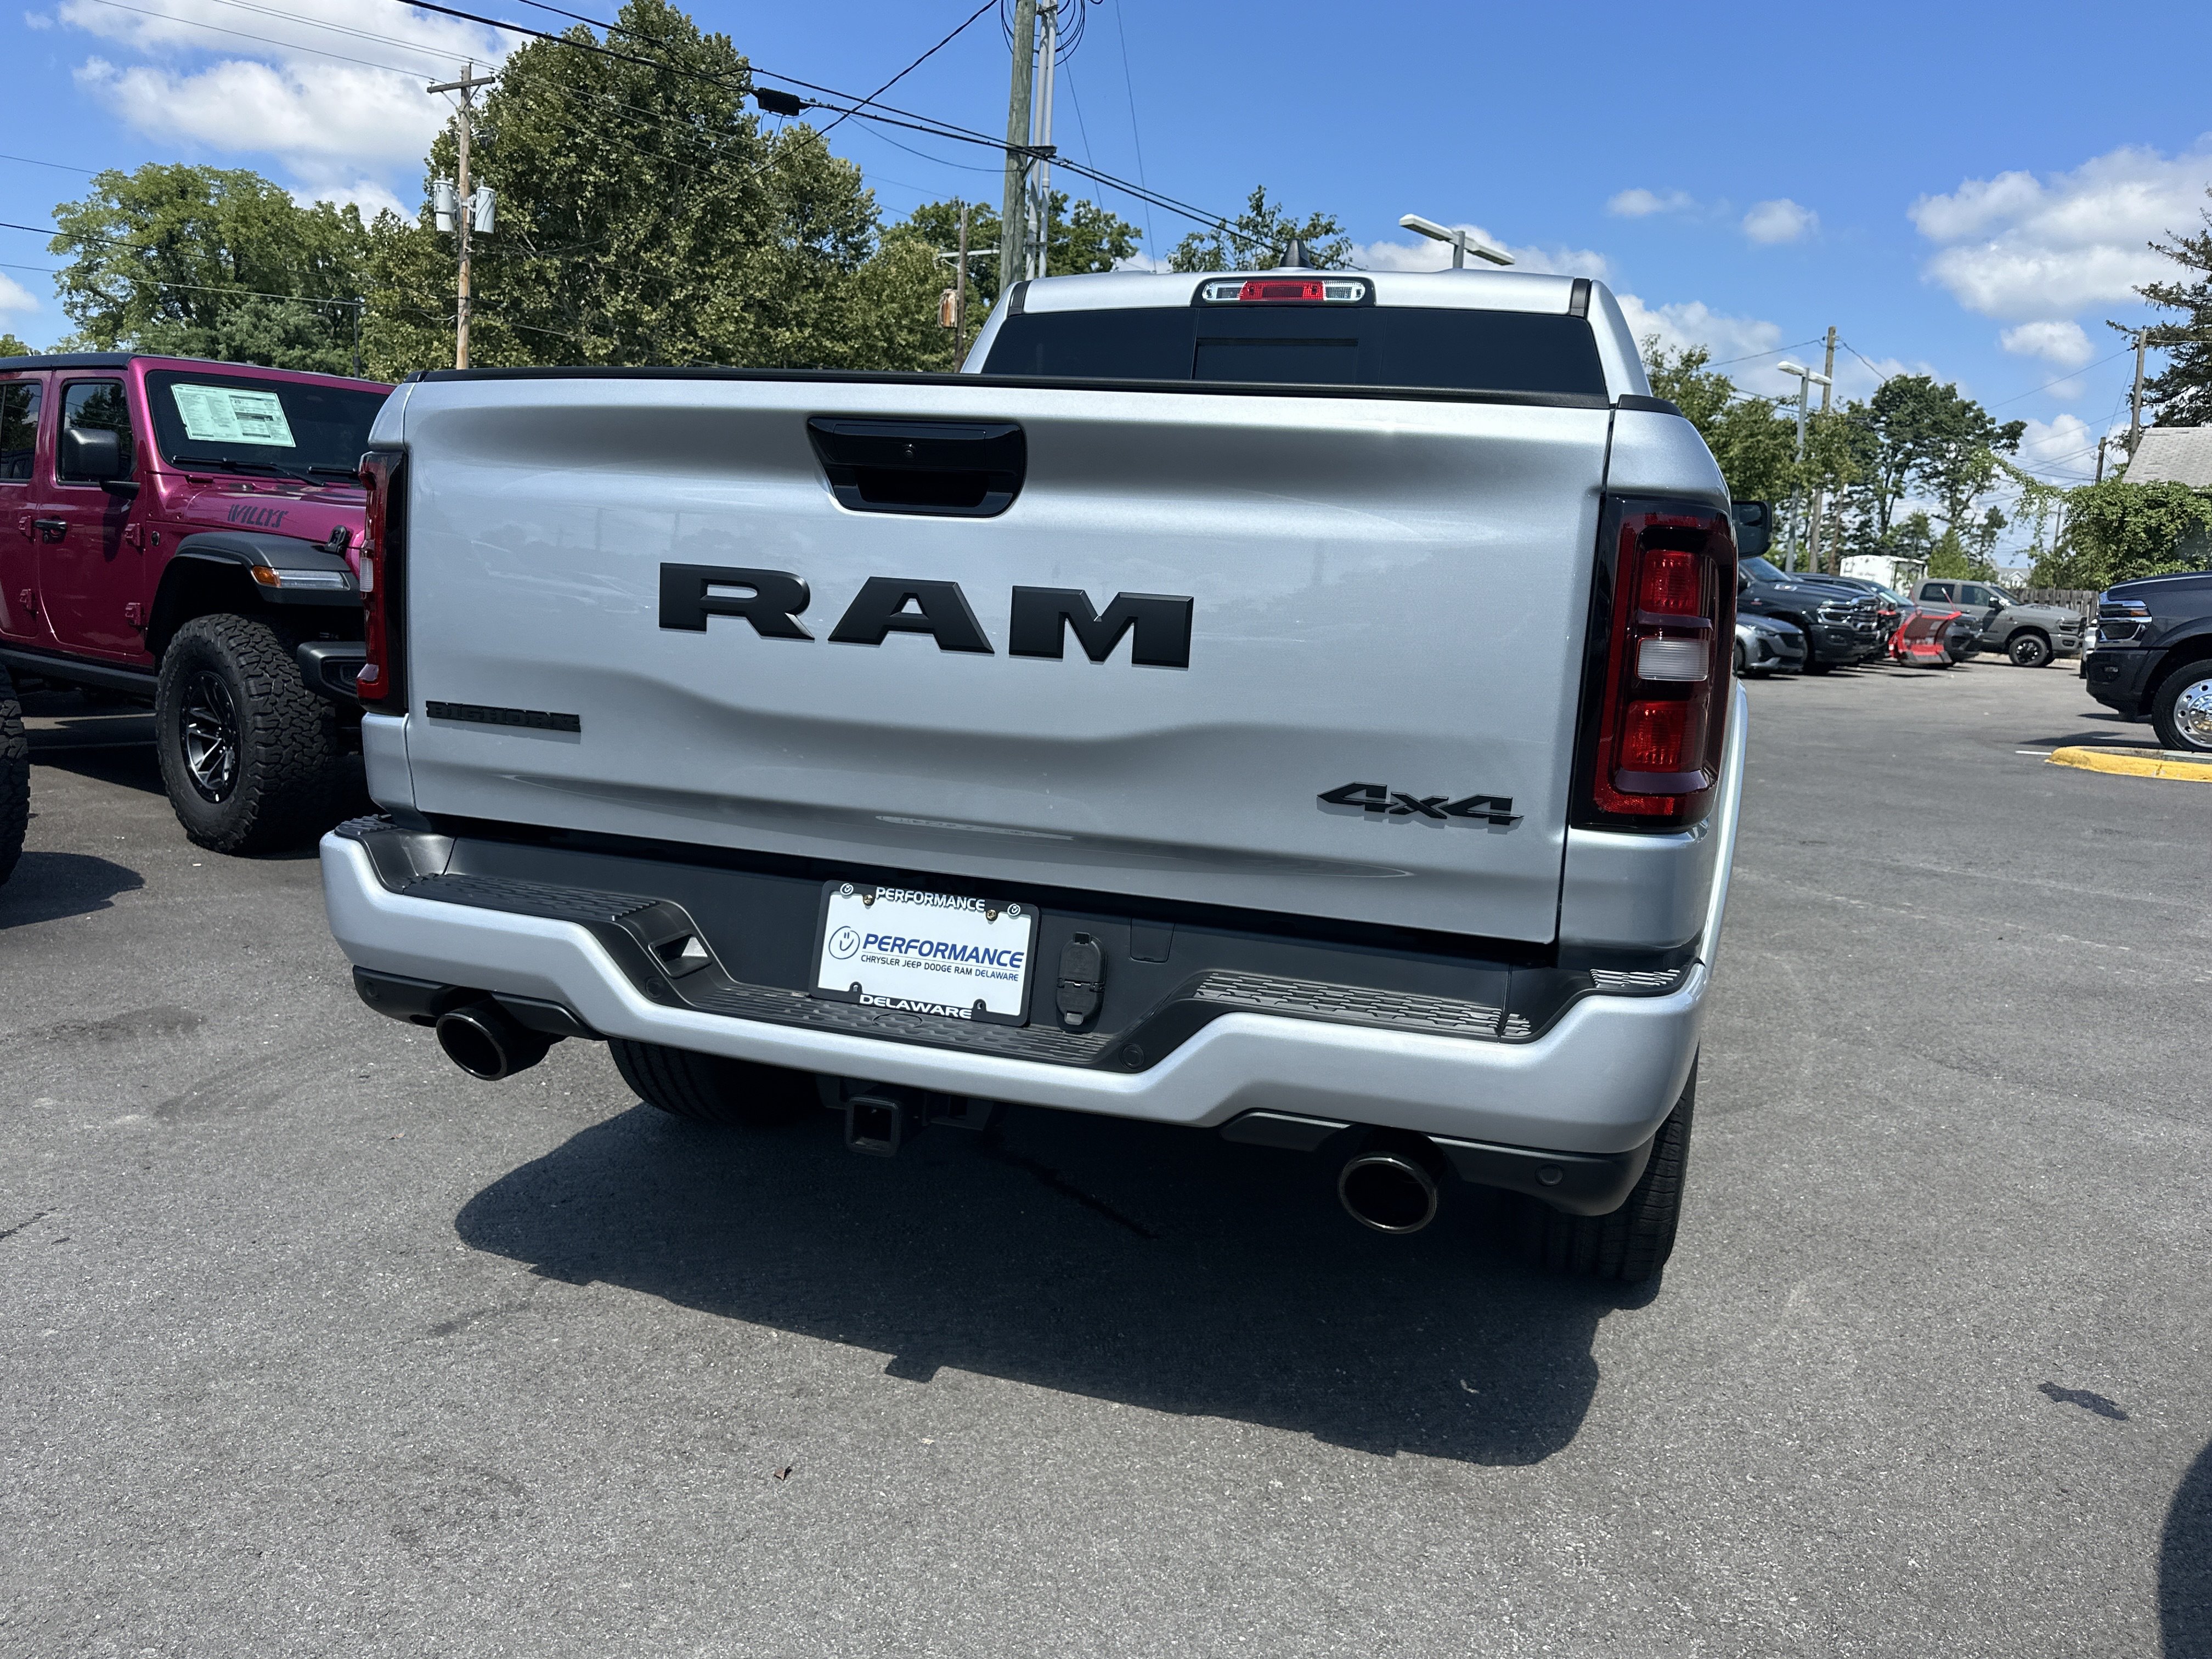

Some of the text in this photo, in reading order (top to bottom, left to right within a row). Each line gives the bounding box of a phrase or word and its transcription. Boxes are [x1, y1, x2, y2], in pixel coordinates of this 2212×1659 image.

[228, 504, 289, 528] WILLYS
[659, 562, 1194, 669] RAM
[1317, 781, 1525, 826] 4x4
[876, 887, 986, 912] PERFORMANCE
[862, 933, 1025, 969] PERFORMANCE
[861, 955, 1019, 981] CHRYSLER JEEP DODGE RAM DELAWARE
[859, 994, 973, 1019] DELAWARE
